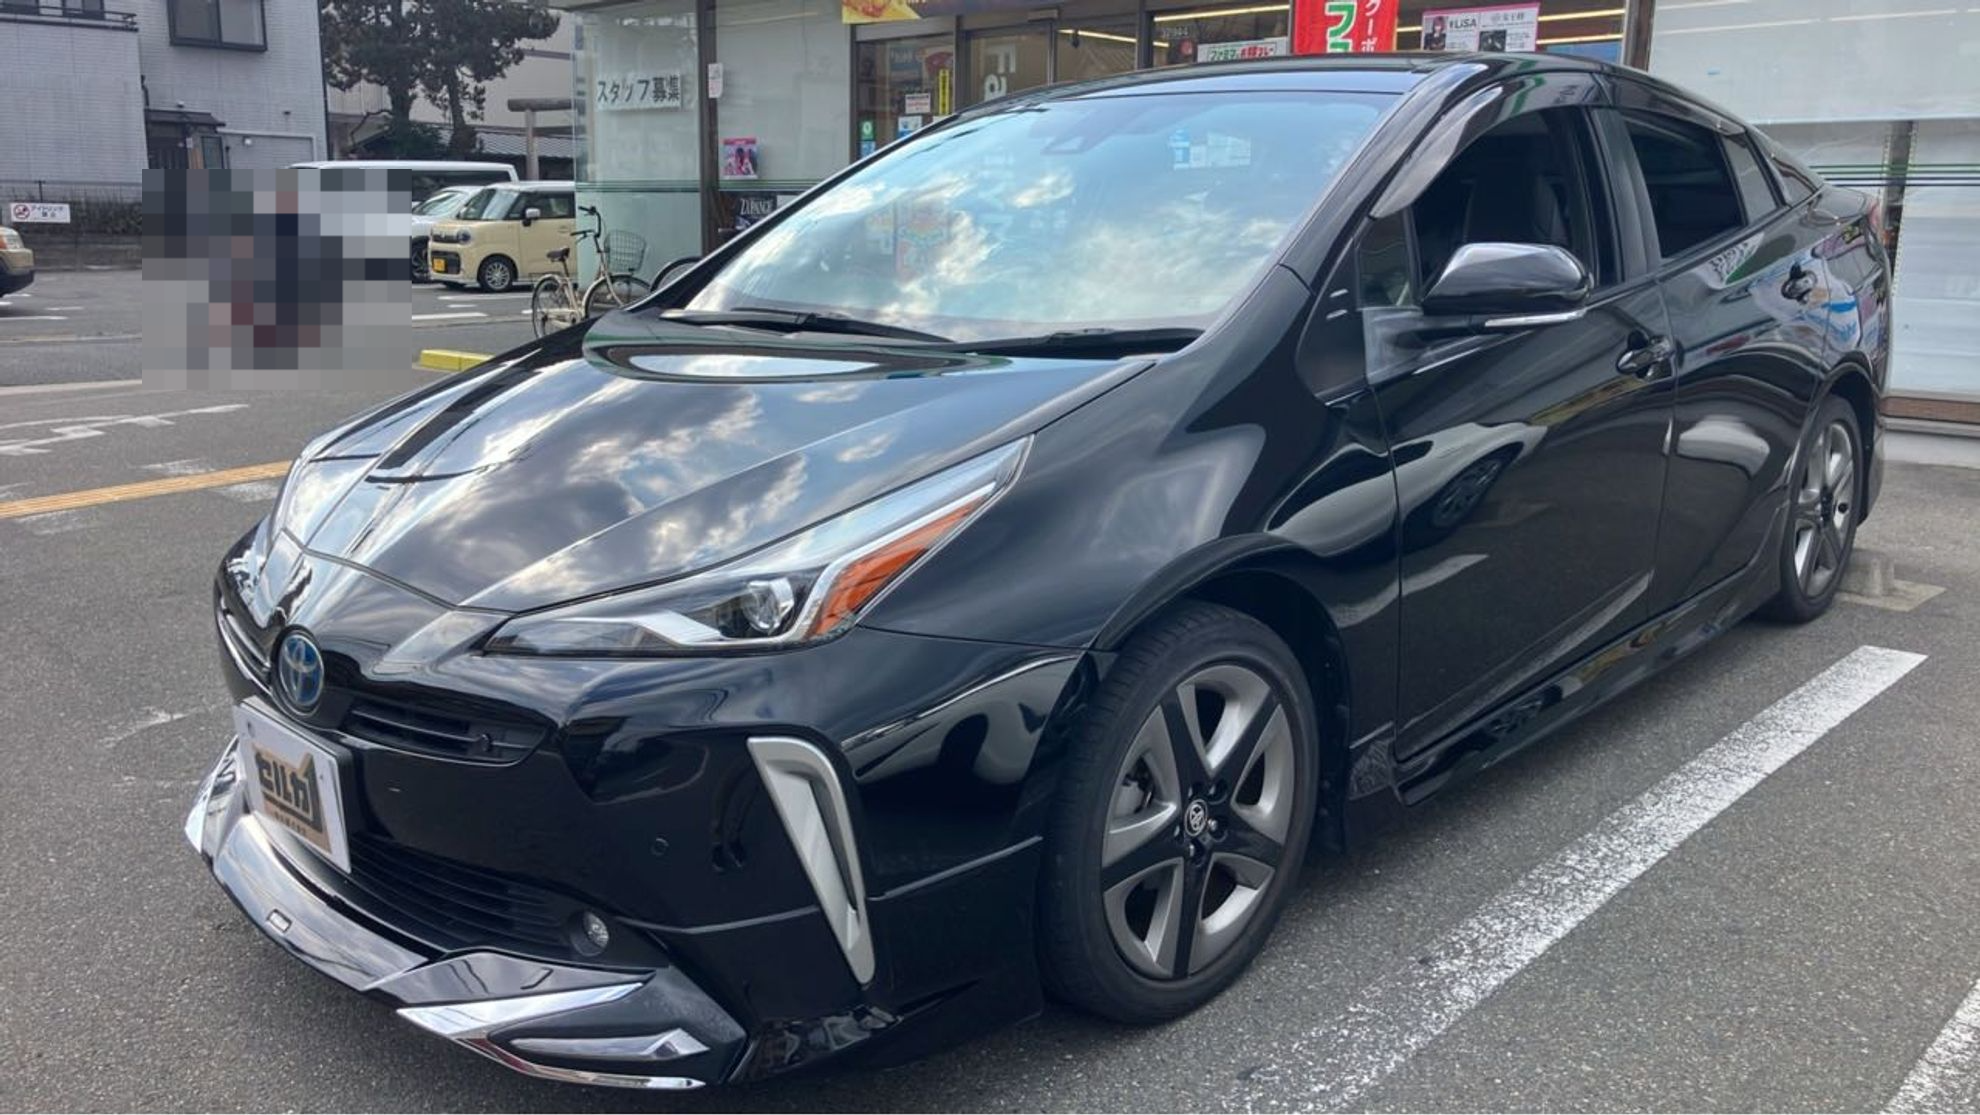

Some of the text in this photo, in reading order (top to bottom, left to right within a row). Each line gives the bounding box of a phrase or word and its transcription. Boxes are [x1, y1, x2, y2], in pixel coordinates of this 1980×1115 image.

[597, 75, 680, 103] スタッフ募集
